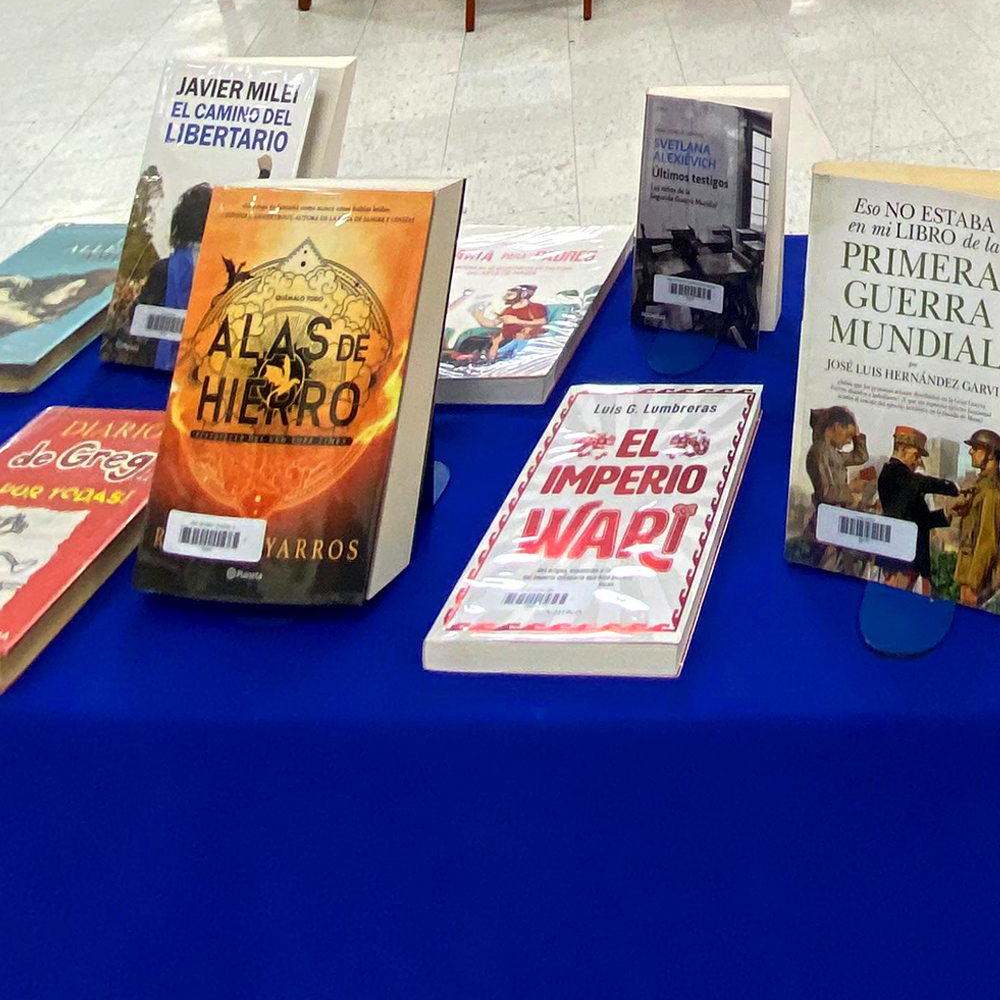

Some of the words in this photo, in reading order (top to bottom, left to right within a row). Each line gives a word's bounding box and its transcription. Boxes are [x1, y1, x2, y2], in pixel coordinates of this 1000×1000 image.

[176, 77, 244, 99] JAVIER
[246, 81, 301, 104] MILEI
[170, 101, 190, 118] EL
[195, 103, 260, 123] CAMINO
[263, 108, 292, 126] DEL
[165, 123, 288, 152] LIBERTARIO
[654, 138, 711, 156] SVETLANA
[652, 164, 690, 183] Últimos
[691, 173, 729, 190] testigos
[853, 197, 881, 216] Eso
[885, 201, 915, 220] NO
[920, 205, 996, 234] ESTABA
[848, 221, 866, 234] en
[872, 221, 893, 238] mi
[895, 223, 957, 246] LIBRO
[962, 234, 980, 250] de
[984, 236, 1000, 254] la
[840, 240, 1000, 293] PRIMERA
[844, 279, 994, 330] GUERRA
[207, 313, 332, 361] ALAS
[337, 334, 370, 363] DE
[824, 358, 853, 372] JOSÉ
[856, 363, 882, 378] LUIS
[885, 368, 960, 390] HERNÁNDEZ
[962, 381, 1000, 397] GARVI
[197, 376, 361, 427] HIERRO
[593, 403, 623, 414] Luis
[626, 403, 639, 414] G.
[643, 403, 717, 414] Lumbreras
[615, 429, 659, 457] EL
[8, 440, 57, 468] de
[56, 441, 158, 483] Greg
[540, 465, 708, 495] IMPERIO
[265, 537, 359, 561] YARROS
[516, 500, 698, 572] WARI
